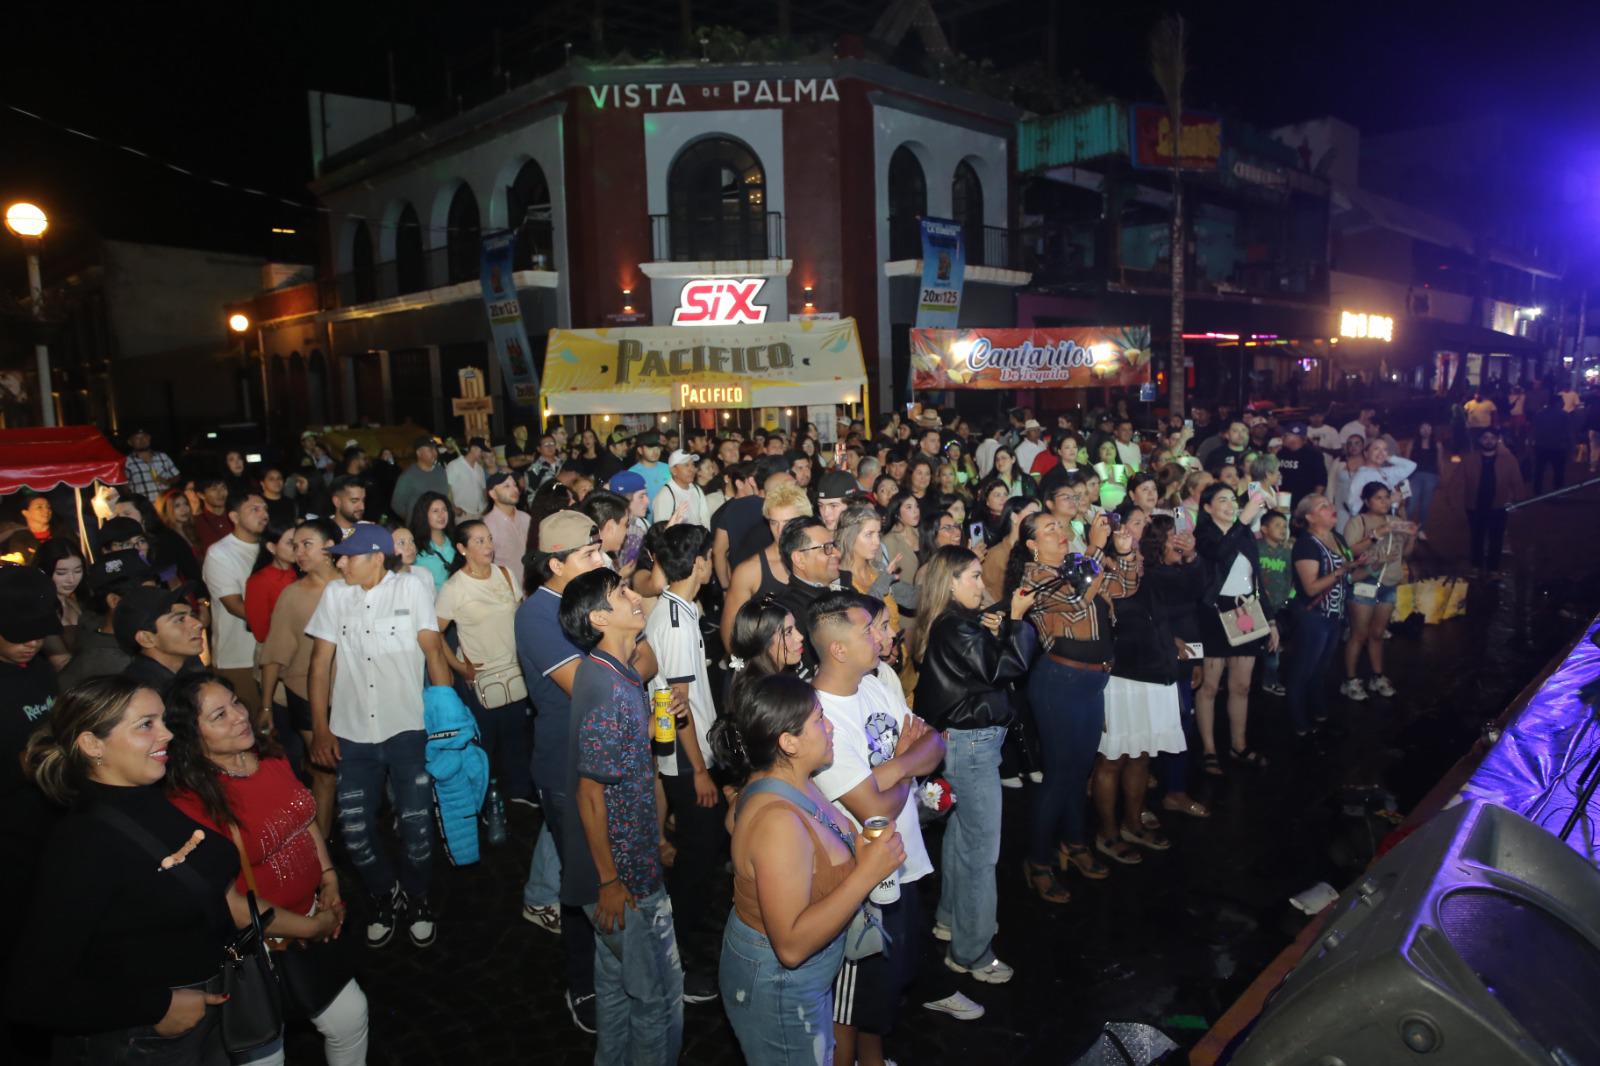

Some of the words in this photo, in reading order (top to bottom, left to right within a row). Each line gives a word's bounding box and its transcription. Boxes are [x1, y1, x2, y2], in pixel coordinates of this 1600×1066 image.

[588, 82, 686, 109] VISTA
[702, 86, 720, 98] DE
[732, 78, 841, 104] PALMA
[614, 338, 796, 385] PACIFICO
[968, 337, 1096, 371] Cantaritos
[1021, 367, 1070, 383] Tequila
[681, 383, 743, 408] PACIFICO
